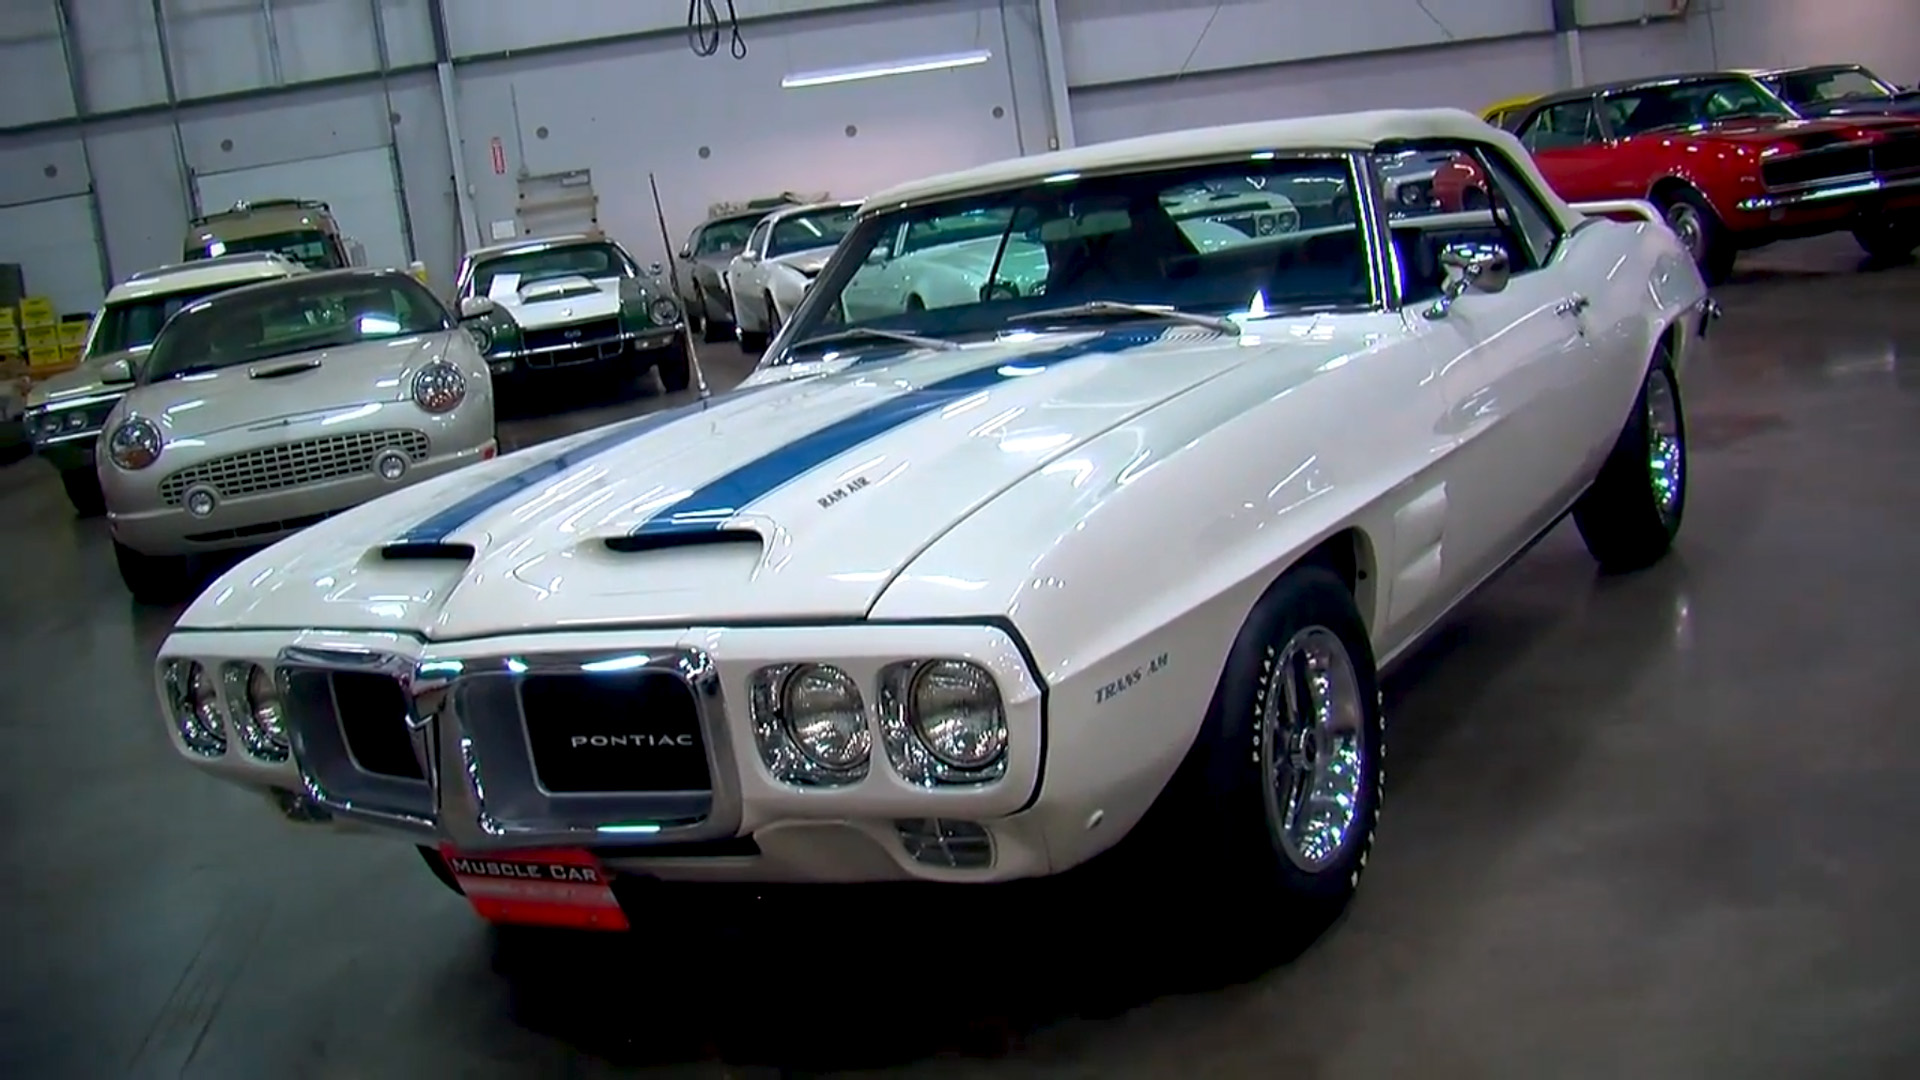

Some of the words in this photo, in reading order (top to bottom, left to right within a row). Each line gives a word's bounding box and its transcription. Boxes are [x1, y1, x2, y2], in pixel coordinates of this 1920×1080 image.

[817, 488, 848, 509] RAM
[846, 476, 871, 493] AIR
[1095, 665, 1142, 704] TRANS
[1251, 645, 1275, 763] POLYGLAS
[571, 733, 693, 748] PONTIAC
[452, 858, 542, 879] MUSCLE
[549, 864, 598, 882] CAR
